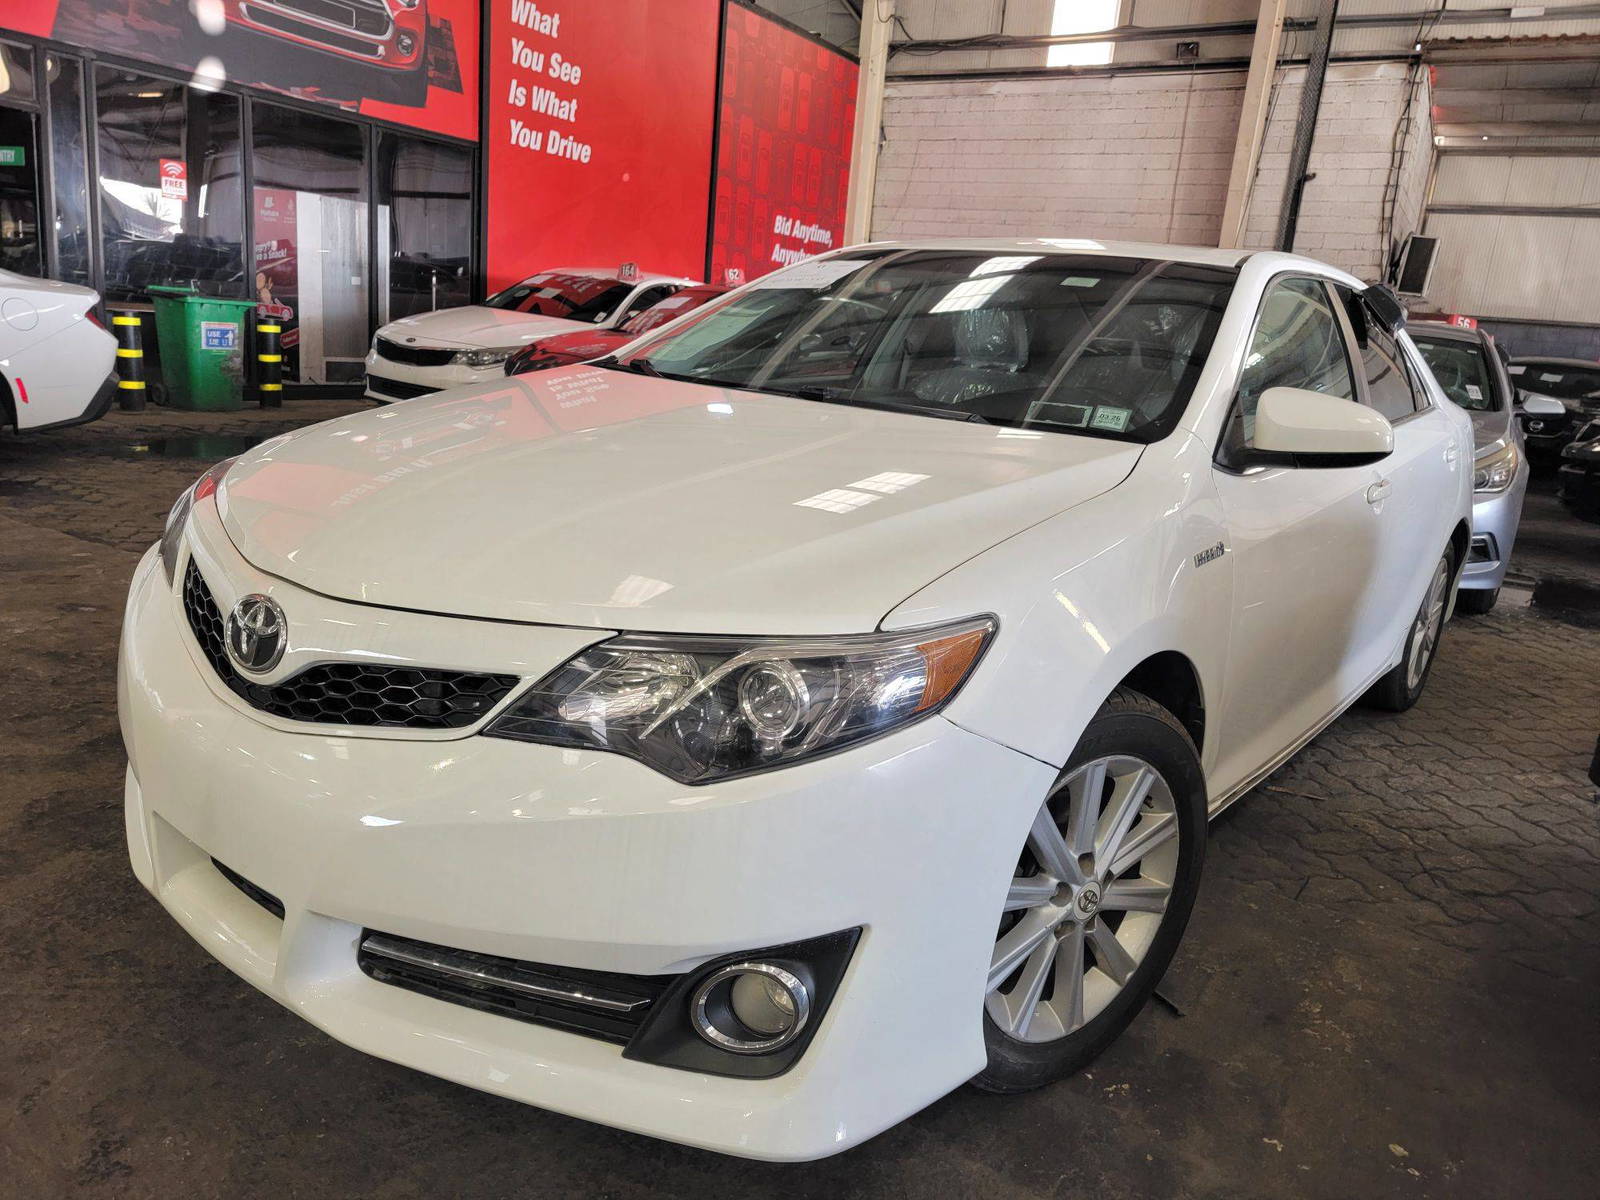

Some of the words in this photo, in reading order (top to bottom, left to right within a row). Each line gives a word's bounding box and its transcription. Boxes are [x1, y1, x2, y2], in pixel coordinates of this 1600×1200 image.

[510, 0, 560, 39] What
[511, 37, 545, 73] You
[549, 52, 582, 85] See
[508, 78, 527, 107] Is
[532, 85, 578, 123] What
[510, 118, 543, 152] You
[546, 129, 592, 164] Drive
[774, 215, 793, 236] Bid
[792, 219, 833, 249] Anytime,
[622, 264, 635, 276] 164
[729, 268, 739, 280] 62
[1457, 316, 1471, 329] 56
